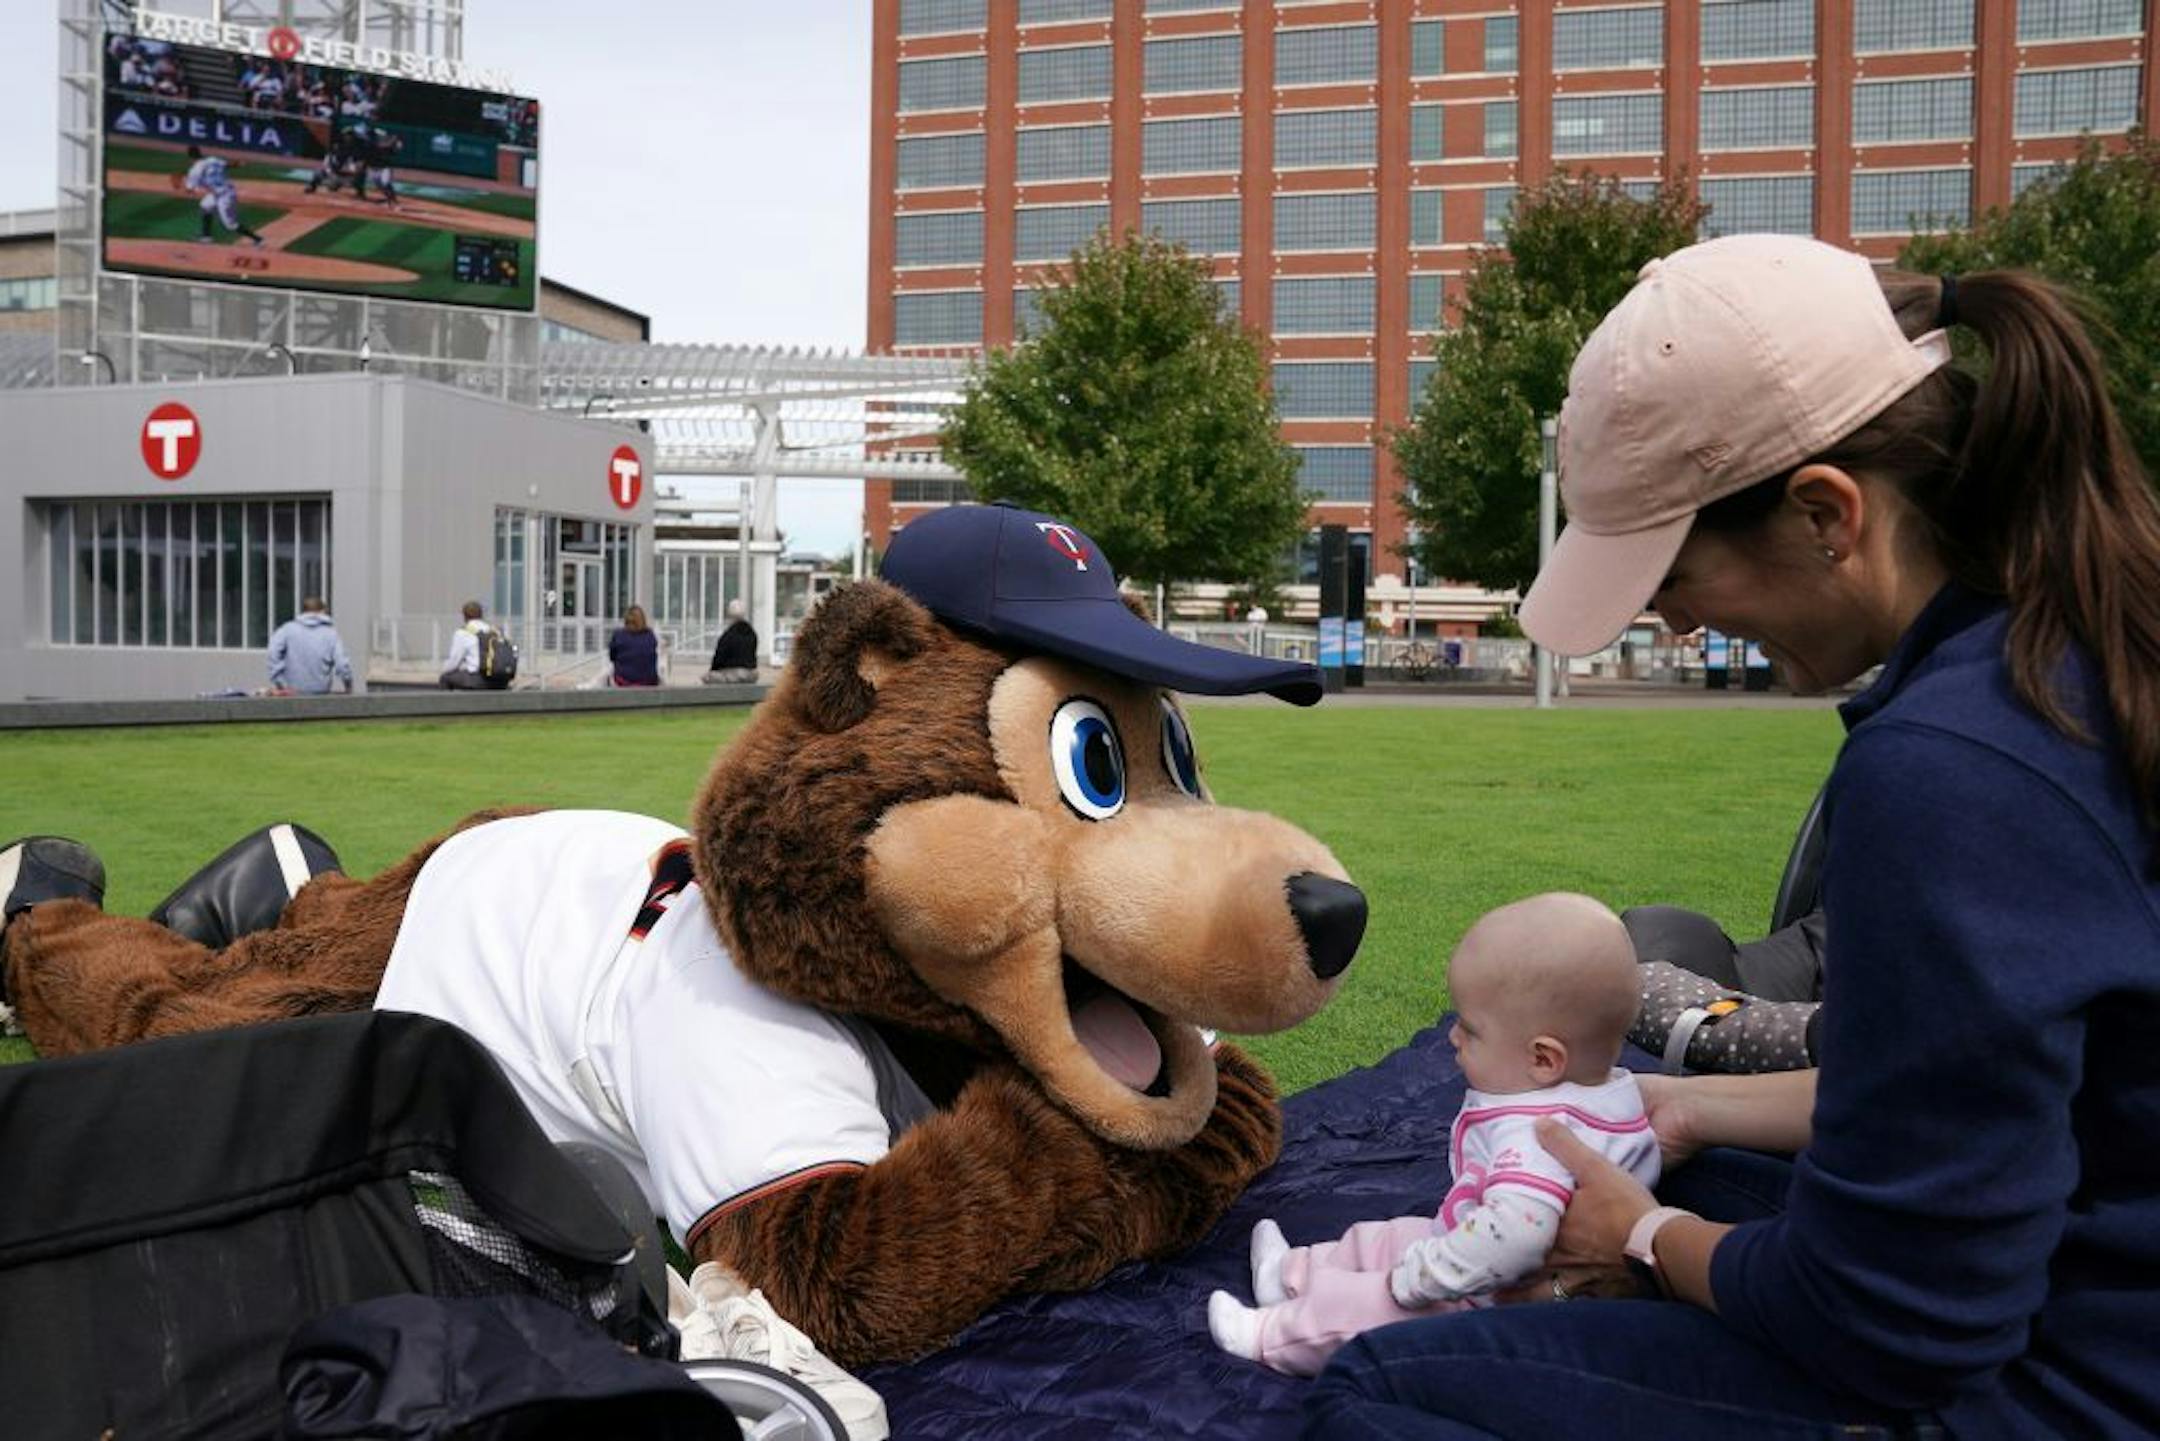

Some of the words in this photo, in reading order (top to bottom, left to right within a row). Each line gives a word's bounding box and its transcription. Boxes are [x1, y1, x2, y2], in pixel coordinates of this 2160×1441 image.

[131, 8, 264, 50] TARGET
[304, 36, 391, 69] FIELD
[148, 420, 194, 472] T
[613, 457, 640, 503] T
